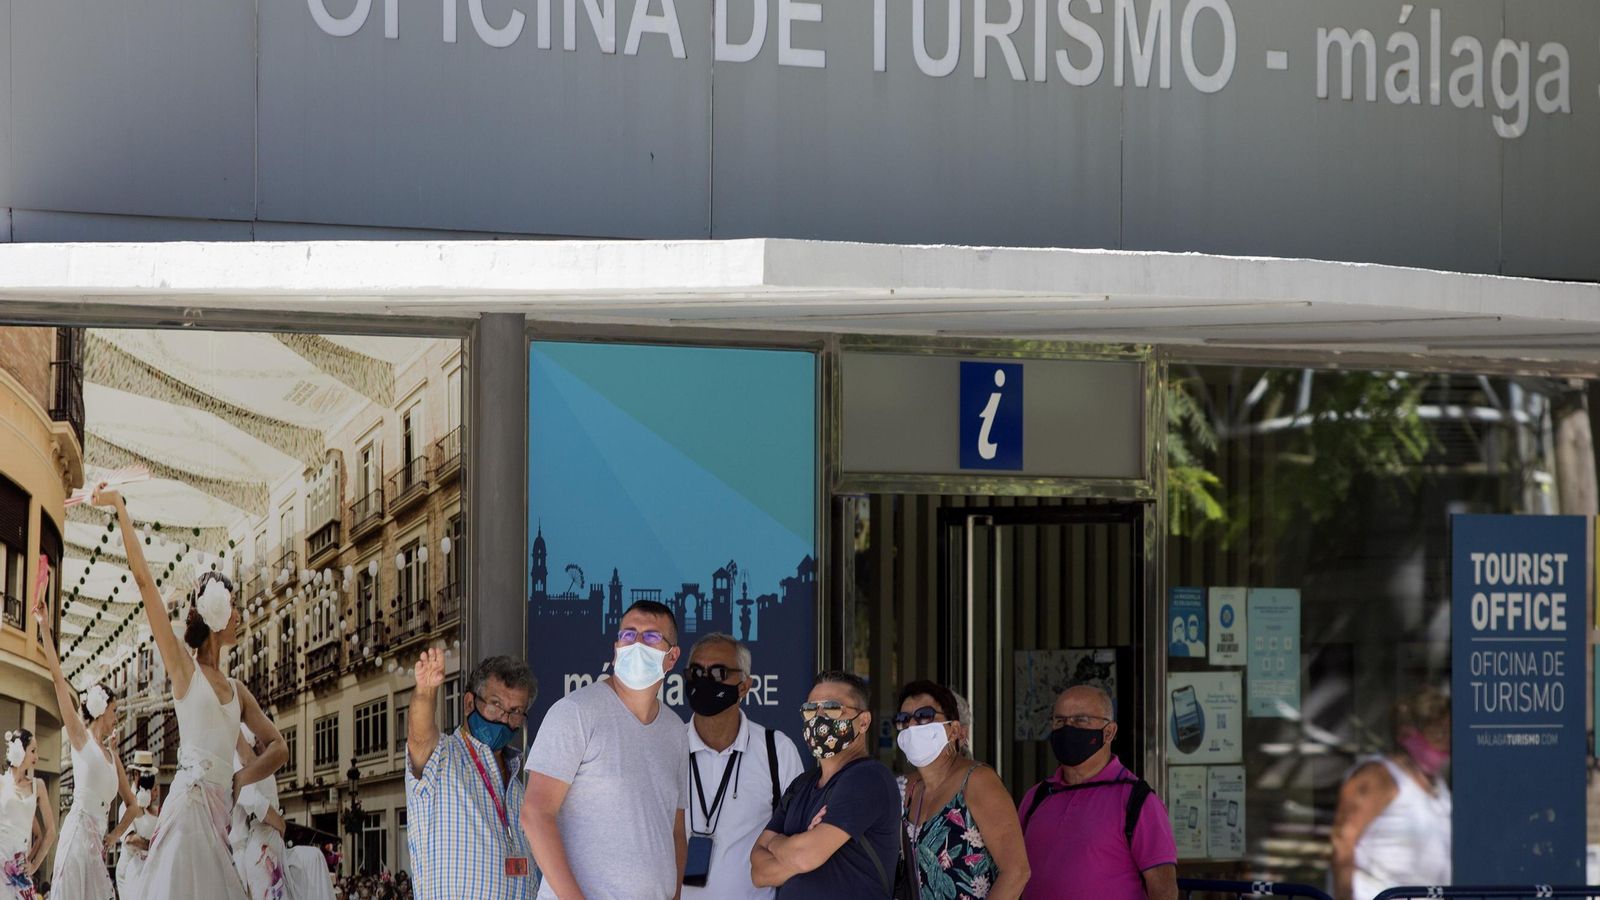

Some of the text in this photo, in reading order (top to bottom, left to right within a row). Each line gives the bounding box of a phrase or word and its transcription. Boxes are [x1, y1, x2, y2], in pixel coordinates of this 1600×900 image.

[714, 0, 826, 69] DE
[1316, 4, 1572, 138] málaga
[1470, 553, 1568, 585] TOURIST
[1471, 592, 1567, 631] OFFICE
[1470, 651, 1565, 676] OFICINA DE
[1470, 681, 1565, 713] TURISMO
